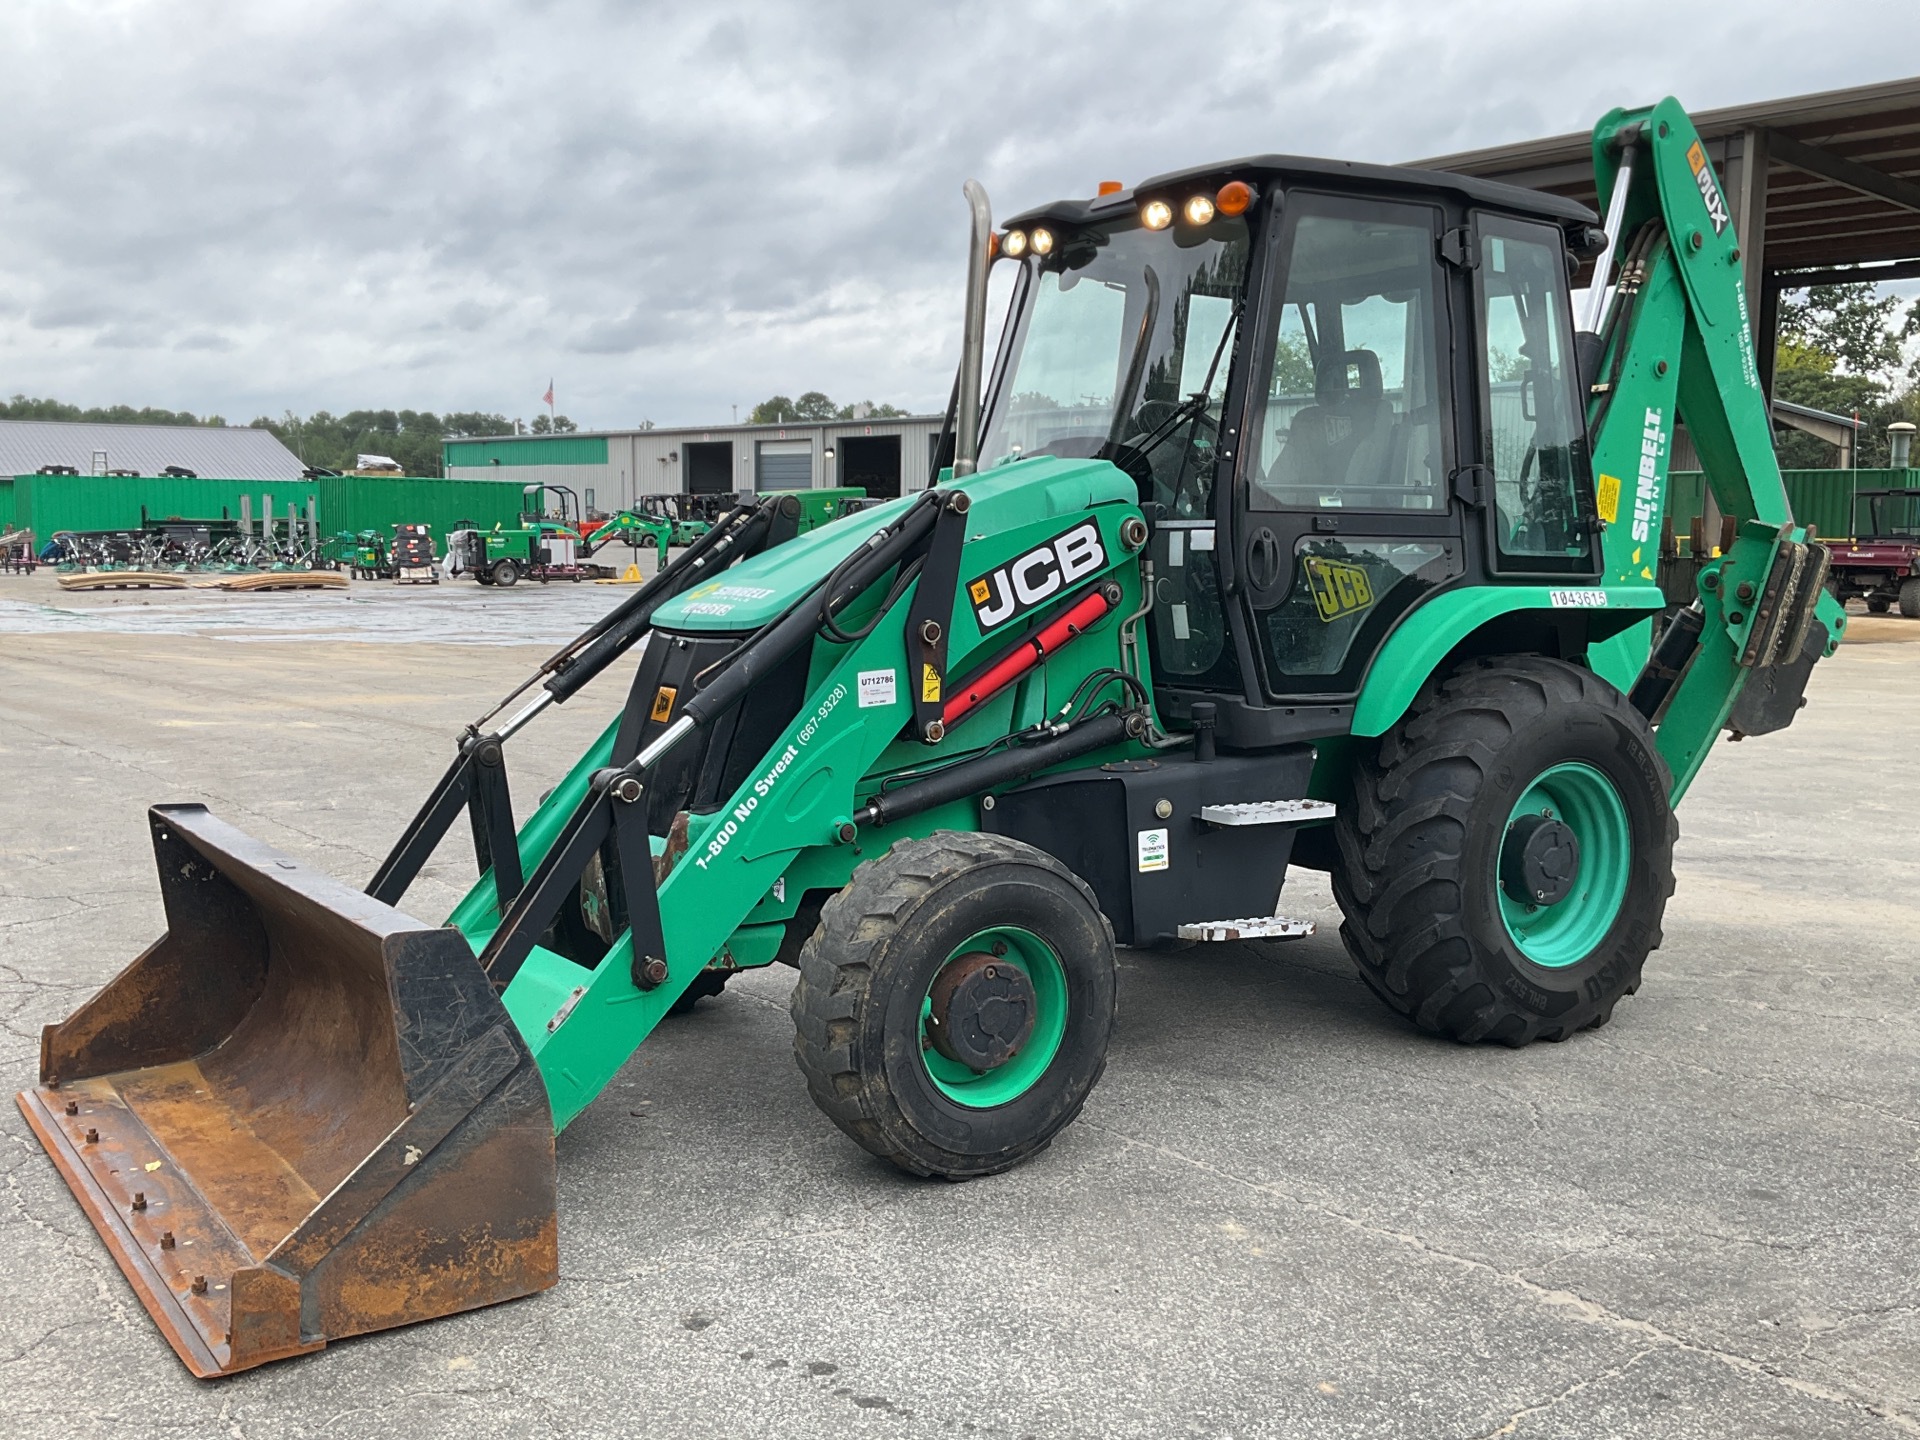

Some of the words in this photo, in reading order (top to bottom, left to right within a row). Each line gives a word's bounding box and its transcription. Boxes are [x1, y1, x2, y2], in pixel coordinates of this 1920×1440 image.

[1697, 166, 1728, 234] 3CX
[1735, 280, 1747, 320] 1-800
[1632, 407, 1661, 543] SUNBELT
[978, 524, 1104, 627] JCB
[1316, 563, 1370, 615] JCB
[1552, 591, 1607, 606] 1043615
[695, 820, 738, 870] 1-800
[733, 796, 758, 823] No
[754, 744, 799, 797] Sweat
[796, 683, 848, 746] (667-9328)
